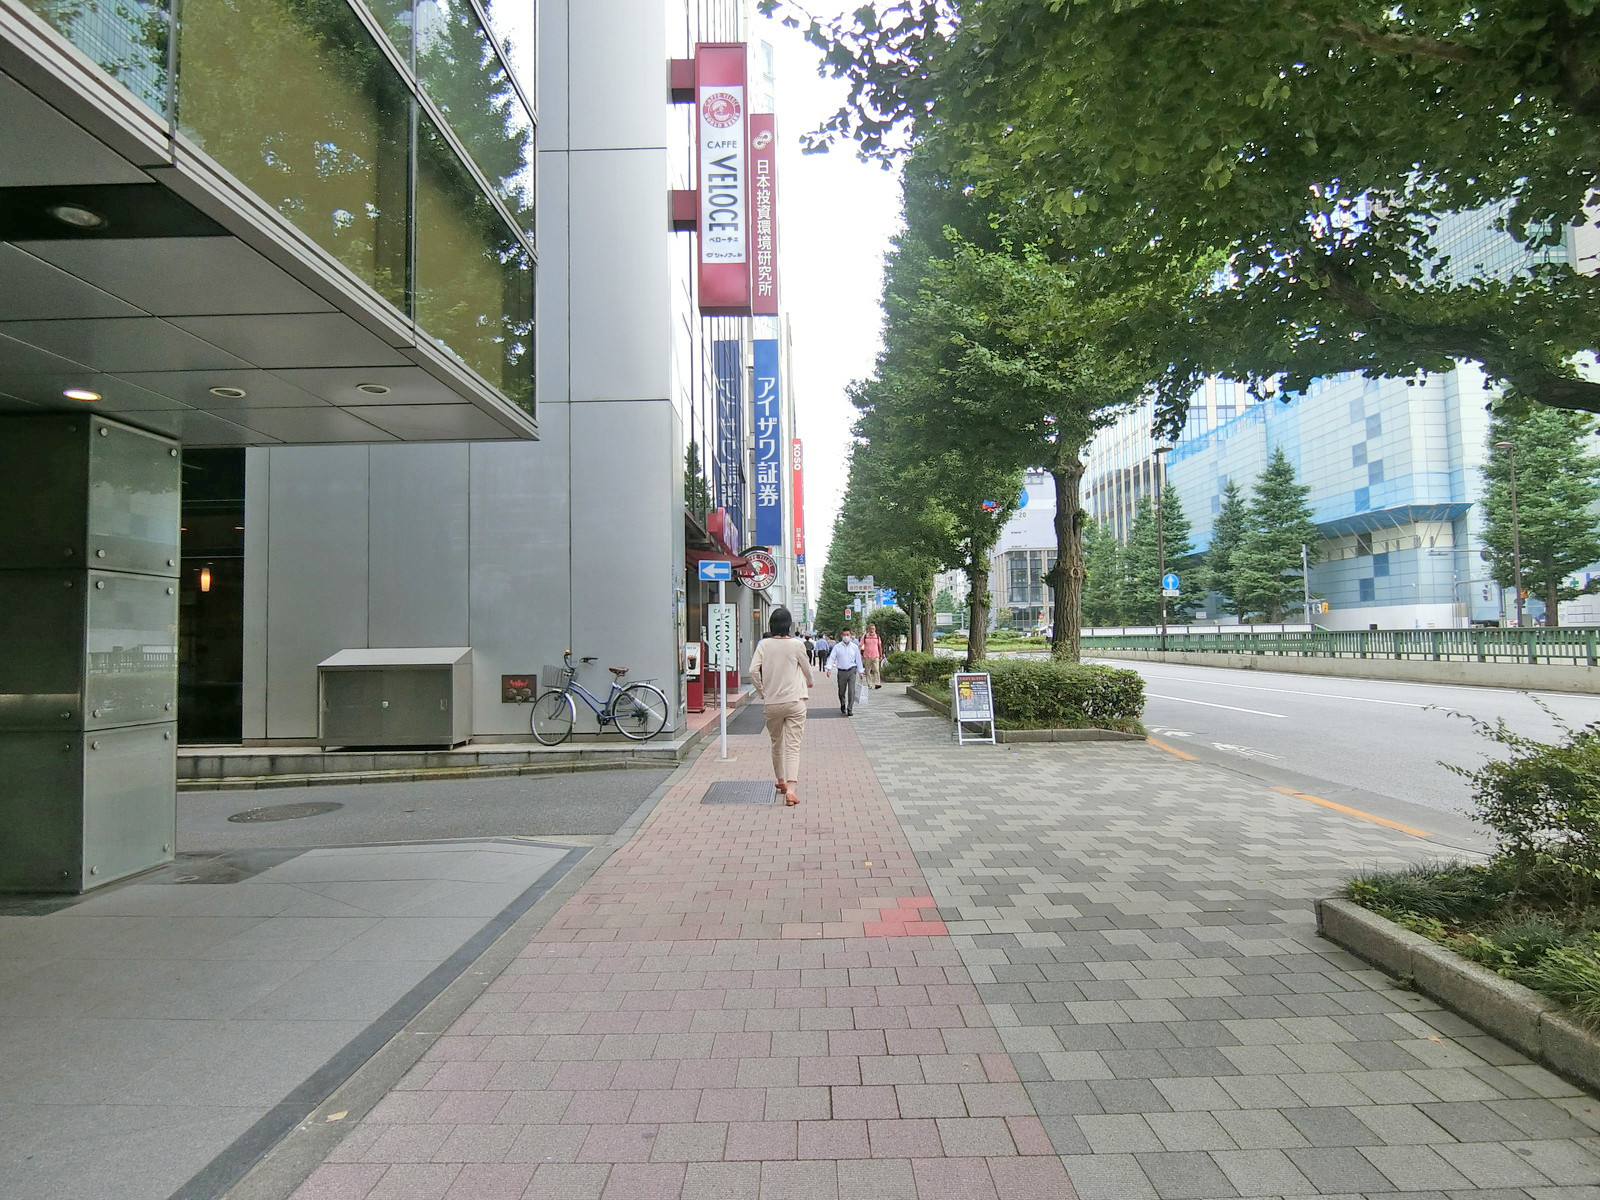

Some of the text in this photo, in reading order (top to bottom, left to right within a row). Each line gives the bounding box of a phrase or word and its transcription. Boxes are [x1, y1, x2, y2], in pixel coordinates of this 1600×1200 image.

[708, 153, 739, 232] VELOCE
[756, 159, 773, 297] 日本投資環境研究所
[757, 377, 779, 507] アイザワ証券
[793, 443, 802, 471] KOSO
